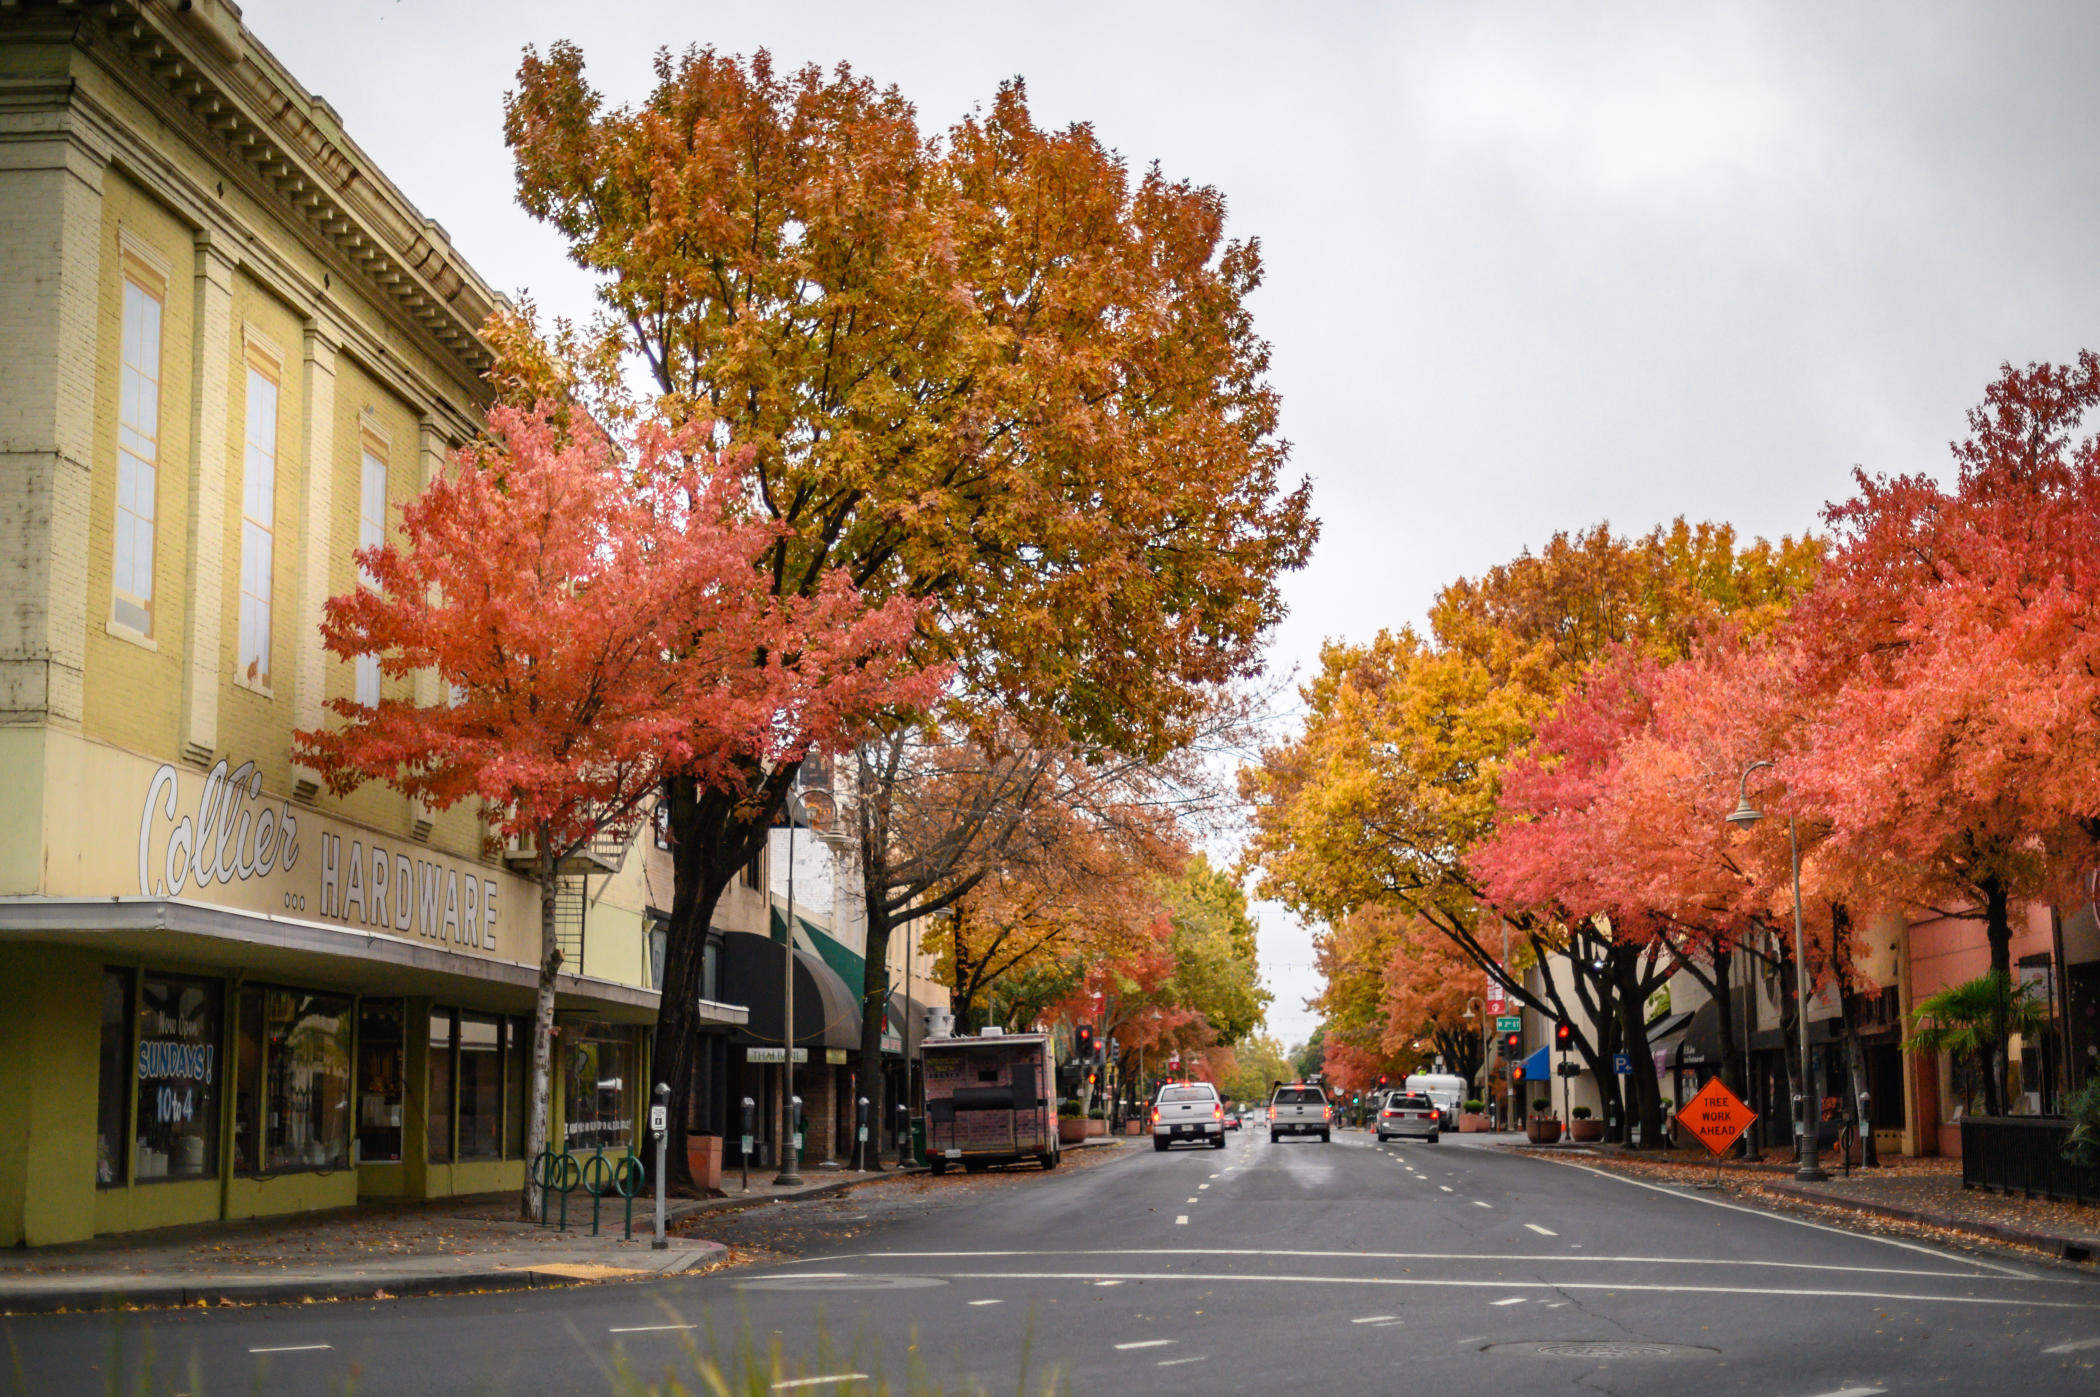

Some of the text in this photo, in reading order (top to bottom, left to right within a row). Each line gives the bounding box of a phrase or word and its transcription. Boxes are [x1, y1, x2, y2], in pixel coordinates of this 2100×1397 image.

[138, 759, 300, 897] Collier
[319, 831, 498, 951] HARDWARE
[138, 1040, 214, 1084] SUNDAYS!
[1615, 1057, 1627, 1072] P
[156, 1085, 193, 1122] 10 to 4
[1704, 1097, 1729, 1107] TREE
[1702, 1111, 1731, 1121] WORK
[1700, 1125, 1736, 1136] AHEAD
